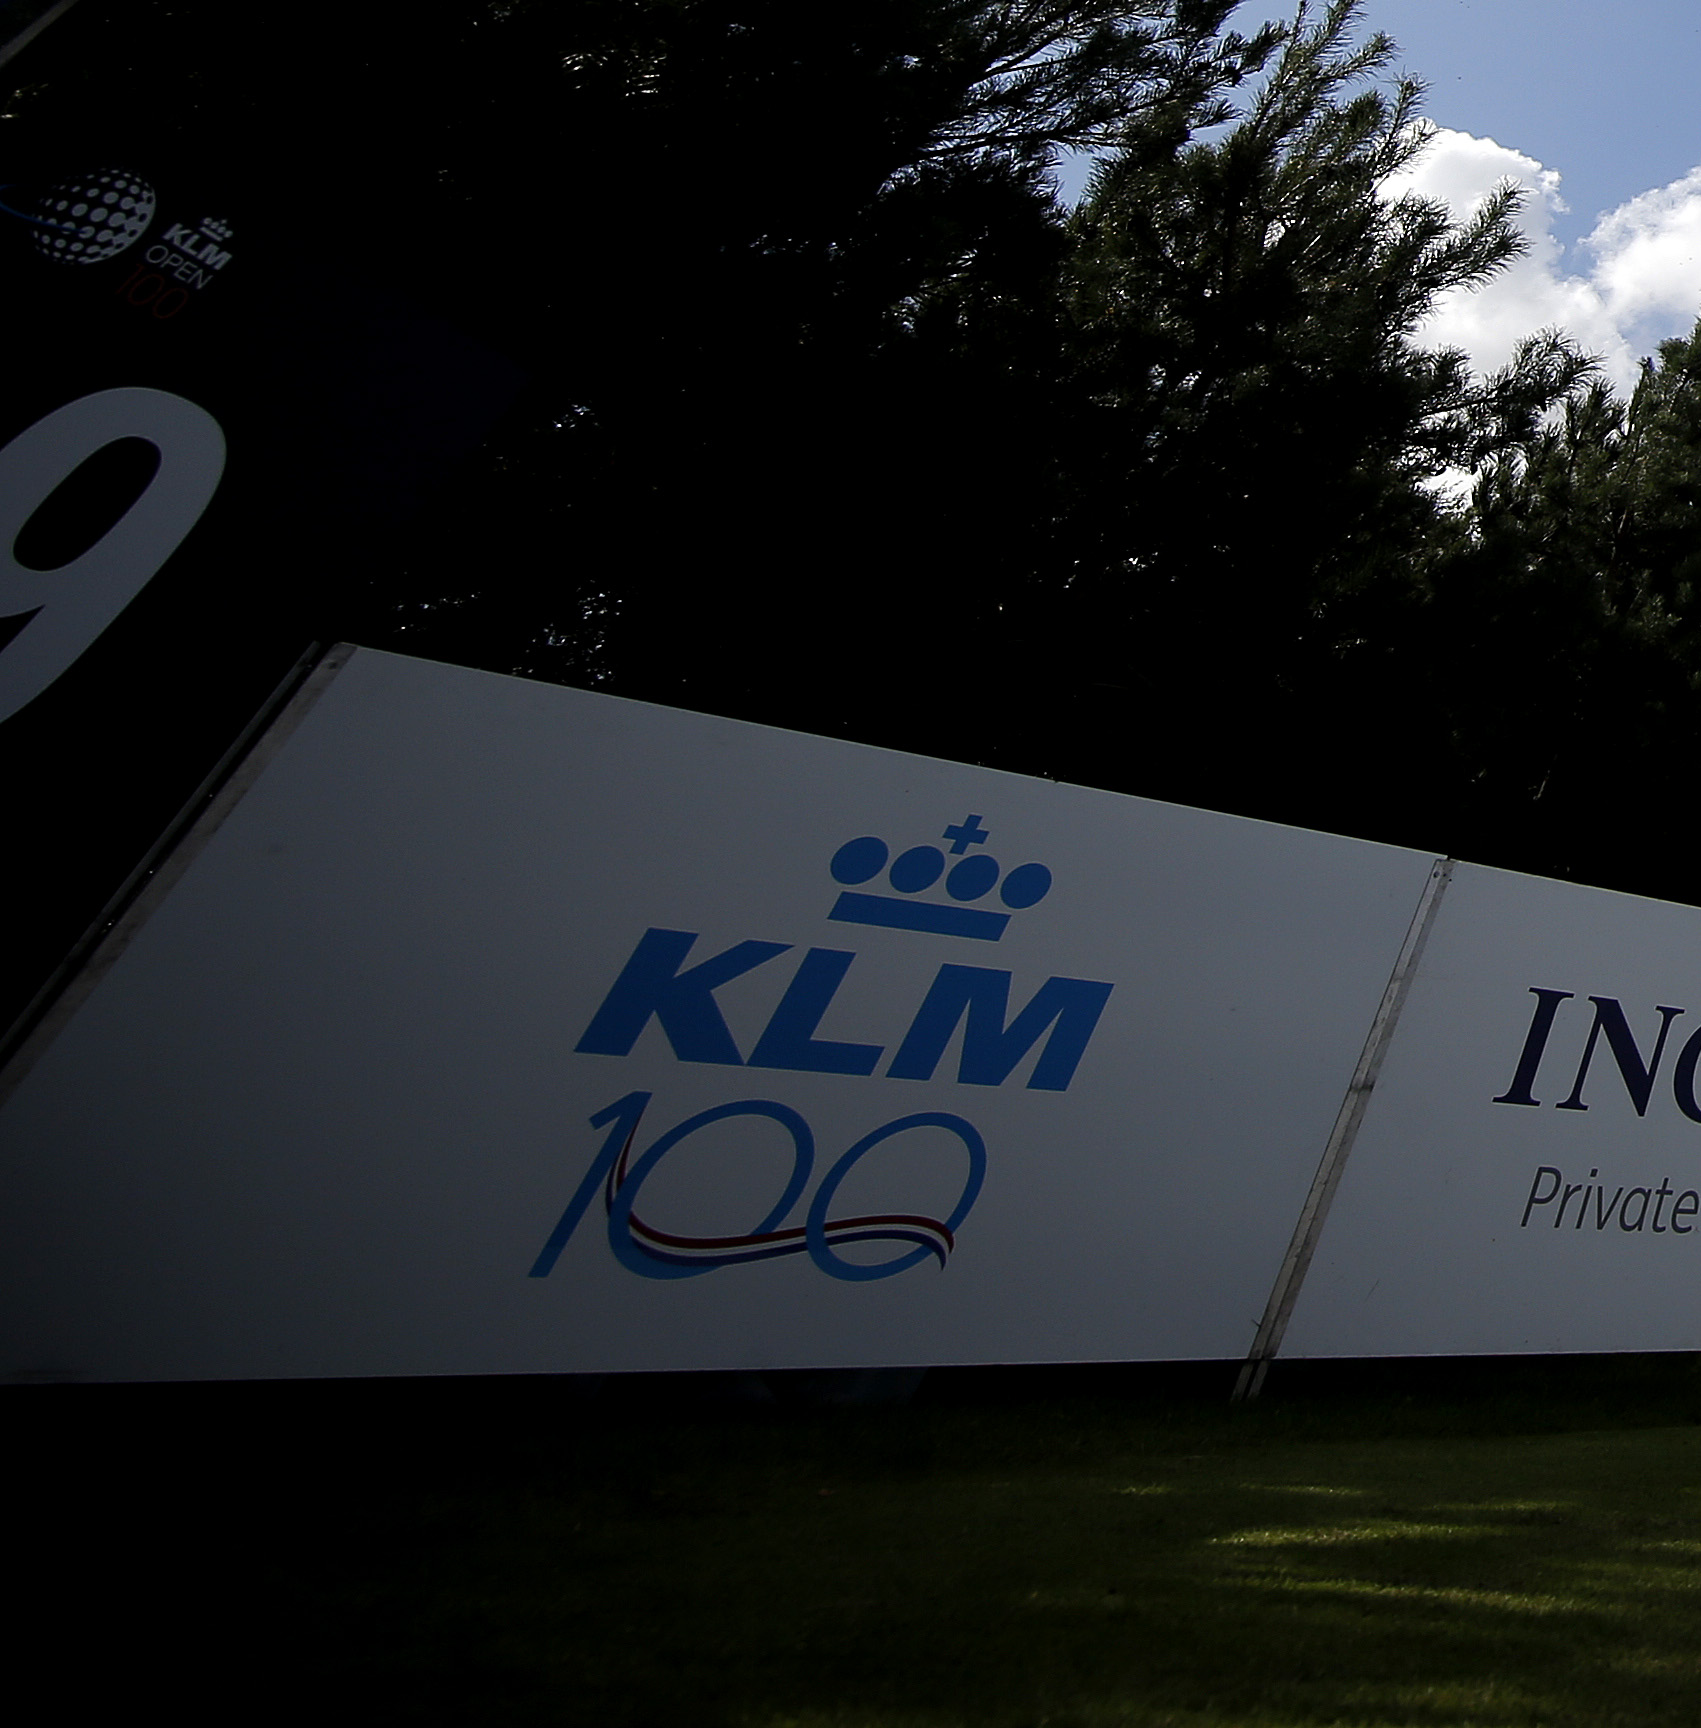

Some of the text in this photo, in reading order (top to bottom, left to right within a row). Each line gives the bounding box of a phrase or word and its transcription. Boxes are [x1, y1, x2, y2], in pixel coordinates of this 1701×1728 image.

[145, 245, 214, 290] OPEN
[161, 222, 233, 271] KLM
[113, 262, 190, 320] 100
[0, 386, 228, 725] 9
[573, 926, 1115, 1092] KLM
[528, 1090, 987, 1282] 100
[1520, 1166, 1700, 1234] Private
